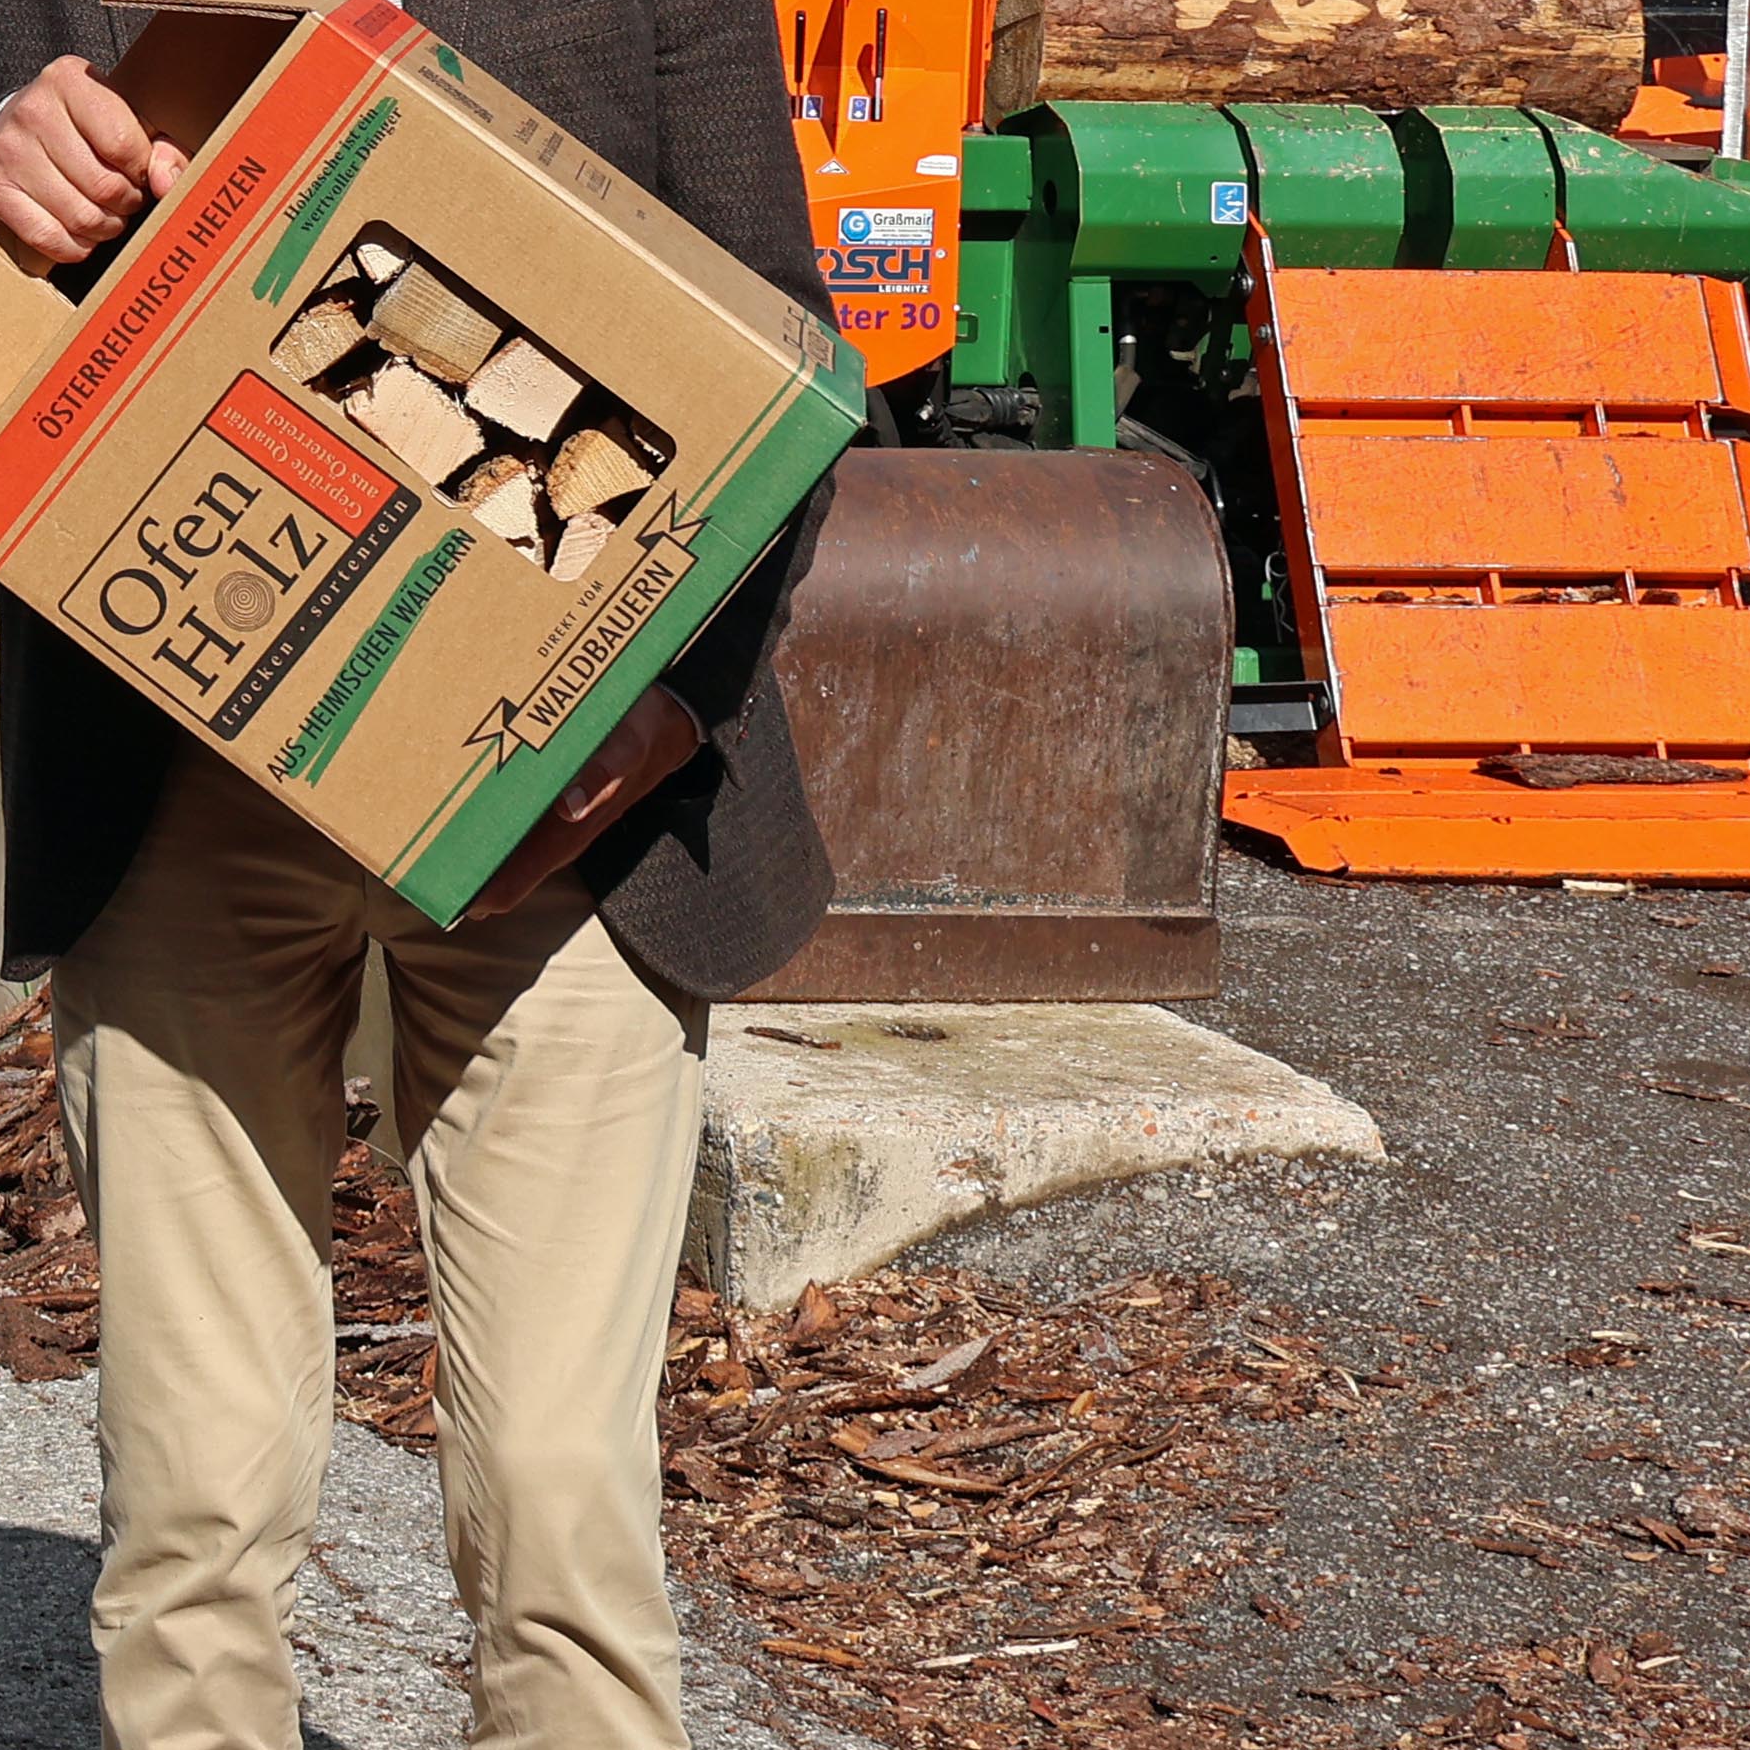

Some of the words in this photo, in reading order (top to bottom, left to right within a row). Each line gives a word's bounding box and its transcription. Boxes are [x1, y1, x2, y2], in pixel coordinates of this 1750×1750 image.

[281, 147, 345, 222] Holzasche
[338, 127, 362, 151] ist
[354, 105, 380, 132] ein
[298, 158, 360, 232] wertvoller
[352, 105, 405, 164] Dünger
[873, 213, 932, 226] Graßmair
[35, 243, 197, 439] ÖSTERREICHISCH
[186, 154, 267, 247] HEIZEN
[900, 302, 940, 330] 30
[221, 404, 289, 462] Qualität
[262, 406, 349, 479] Österreich
[281, 453, 364, 520] Geprüfte
[348, 470, 380, 499] aus
[98, 469, 261, 636] Ofen
[220, 640, 294, 726] trocken
[308, 497, 409, 618] sortenrein
[265, 740, 307, 783] AUS
[298, 621, 400, 740] HEIMISCHEN
[387, 525, 476, 624] WÄLDERN
[526, 558, 675, 728] WALDBAUERN
[536, 610, 577, 658] DIREKT
[576, 578, 604, 608] VOM
